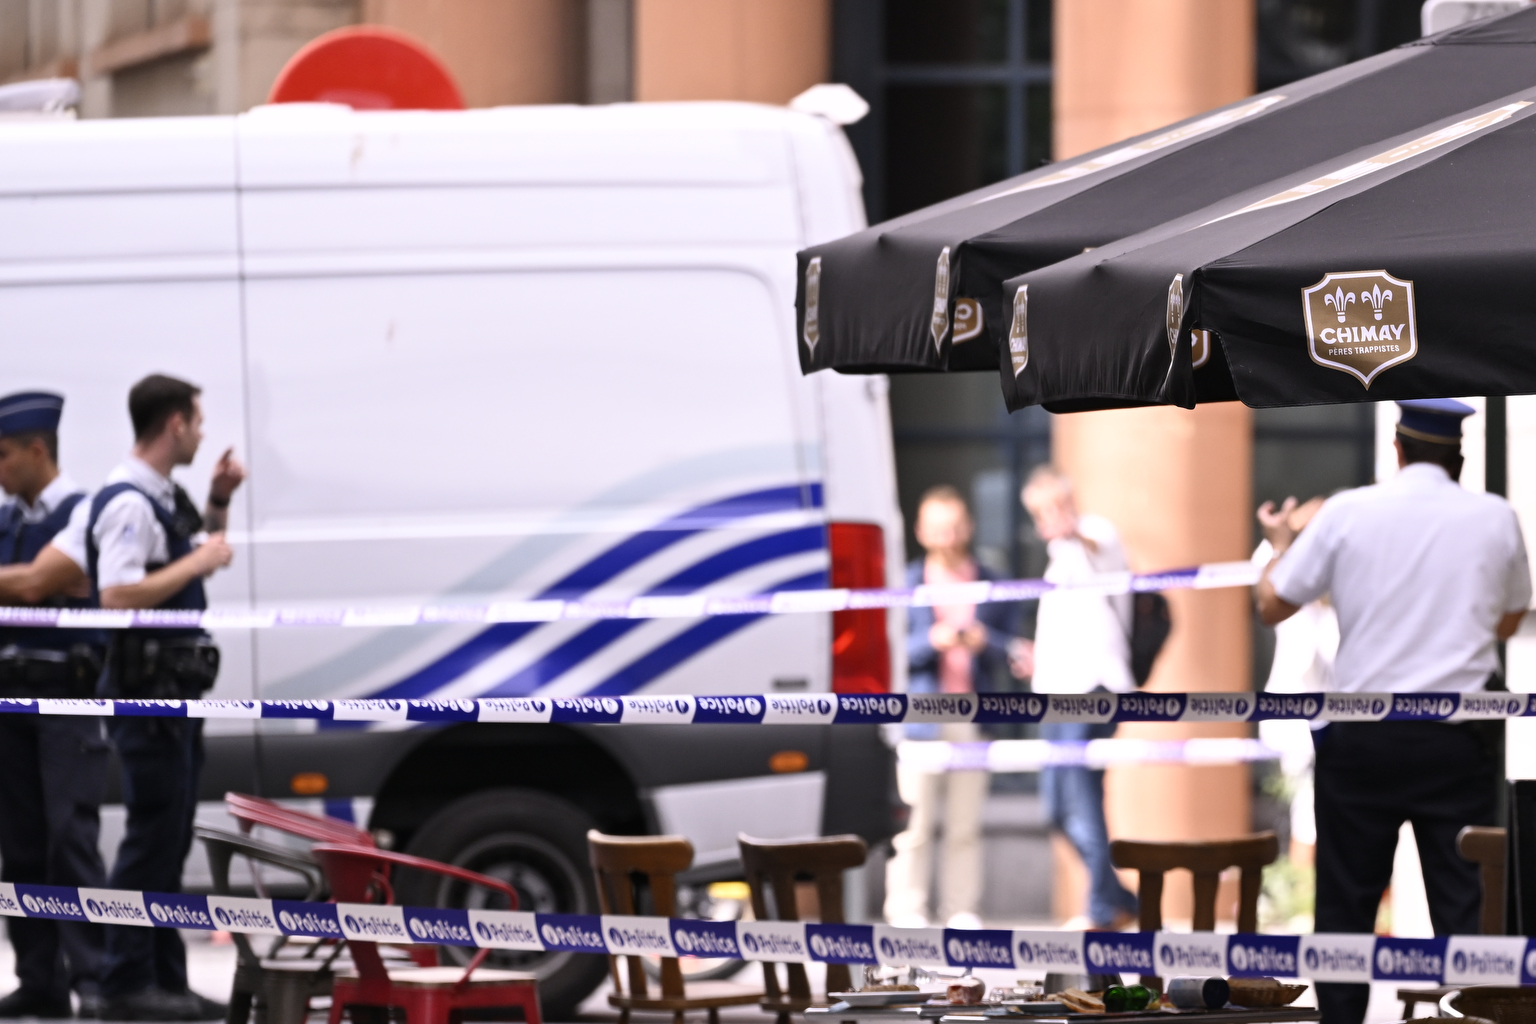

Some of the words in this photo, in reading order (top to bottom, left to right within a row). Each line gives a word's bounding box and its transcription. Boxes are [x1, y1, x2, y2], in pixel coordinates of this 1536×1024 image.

[1319, 323, 1406, 345] CHIMAY
[1328, 346, 1353, 356] PÈRES
[1354, 344, 1400, 355] TRAPPISTES
[700, 696, 747, 714] Police
[772, 698, 816, 714] Politie
[842, 696, 889, 714] Police
[913, 697, 957, 715] Politie
[983, 698, 1026, 715] Police
[1122, 698, 1165, 716] Police
[1259, 698, 1301, 715] Police
[1396, 698, 1439, 716] Police
[37, 896, 82, 916] Police
[100, 898, 144, 920] Politie
[164, 903, 210, 926] Police
[229, 908, 272, 929] Politie
[296, 913, 340, 935] Police
[360, 916, 404, 937] Politie
[425, 920, 471, 941] Police
[491, 922, 534, 944] Politie
[555, 926, 604, 949] Police
[623, 930, 670, 951] Politie
[689, 931, 738, 954] Police
[758, 934, 802, 955] Politie
[826, 936, 874, 959] Police
[895, 938, 939, 960] Politie
[965, 940, 1013, 964] Police
[1033, 942, 1080, 965] Politie
[1102, 942, 1151, 968] Police
[1177, 945, 1222, 968] Politie
[1250, 946, 1298, 971] Police
[1319, 947, 1367, 971] Politie
[1393, 948, 1442, 974] Police
[1469, 950, 1516, 975] Politie
